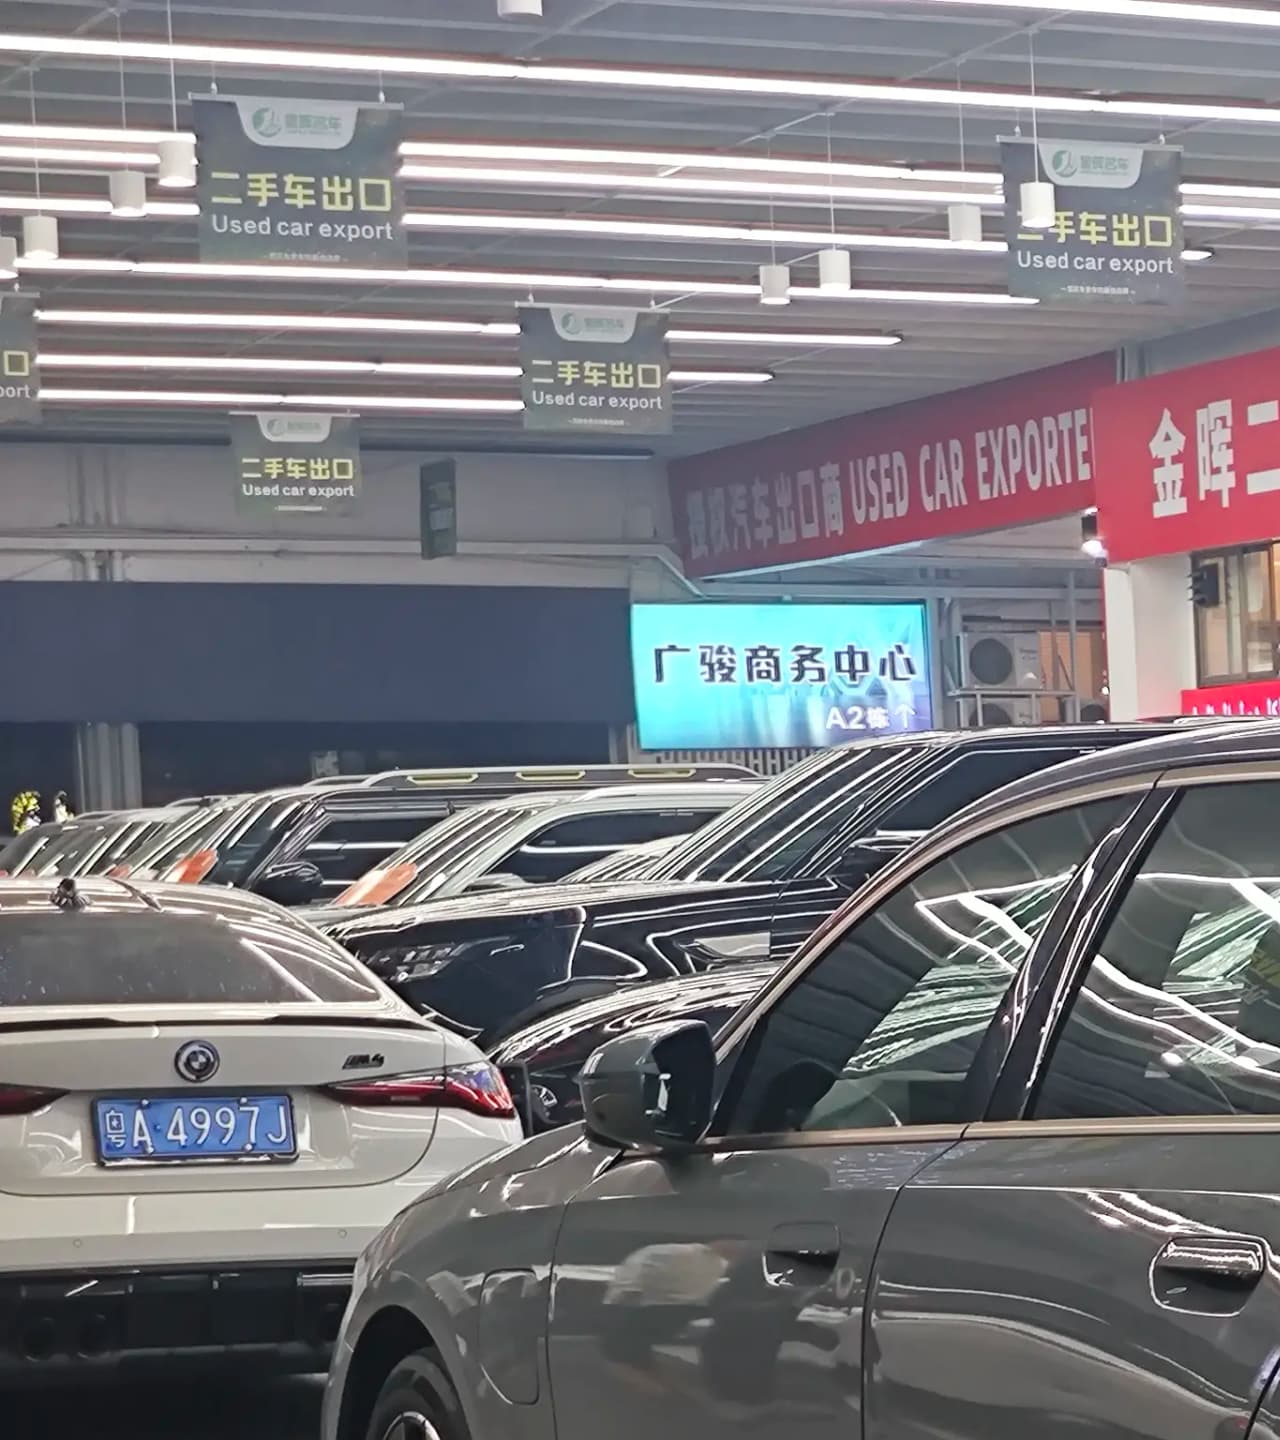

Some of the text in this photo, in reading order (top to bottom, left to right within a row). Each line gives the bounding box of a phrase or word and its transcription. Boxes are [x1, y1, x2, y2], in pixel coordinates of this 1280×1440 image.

[211, 172, 392, 212] 二手车出口
[211, 214, 393, 242] Used car export
[1017, 250, 1174, 276] Used car export
[532, 359, 662, 389] 二手车出口
[532, 390, 663, 411] Used car export
[242, 457, 353, 480] 二手车出口
[850, 450, 909, 525] USED
[919, 439, 968, 513] CAR
[975, 408, 1097, 501] EXPORTE
[242, 483, 355, 498] Used car export
[653, 643, 918, 684] 广骏商务中心
